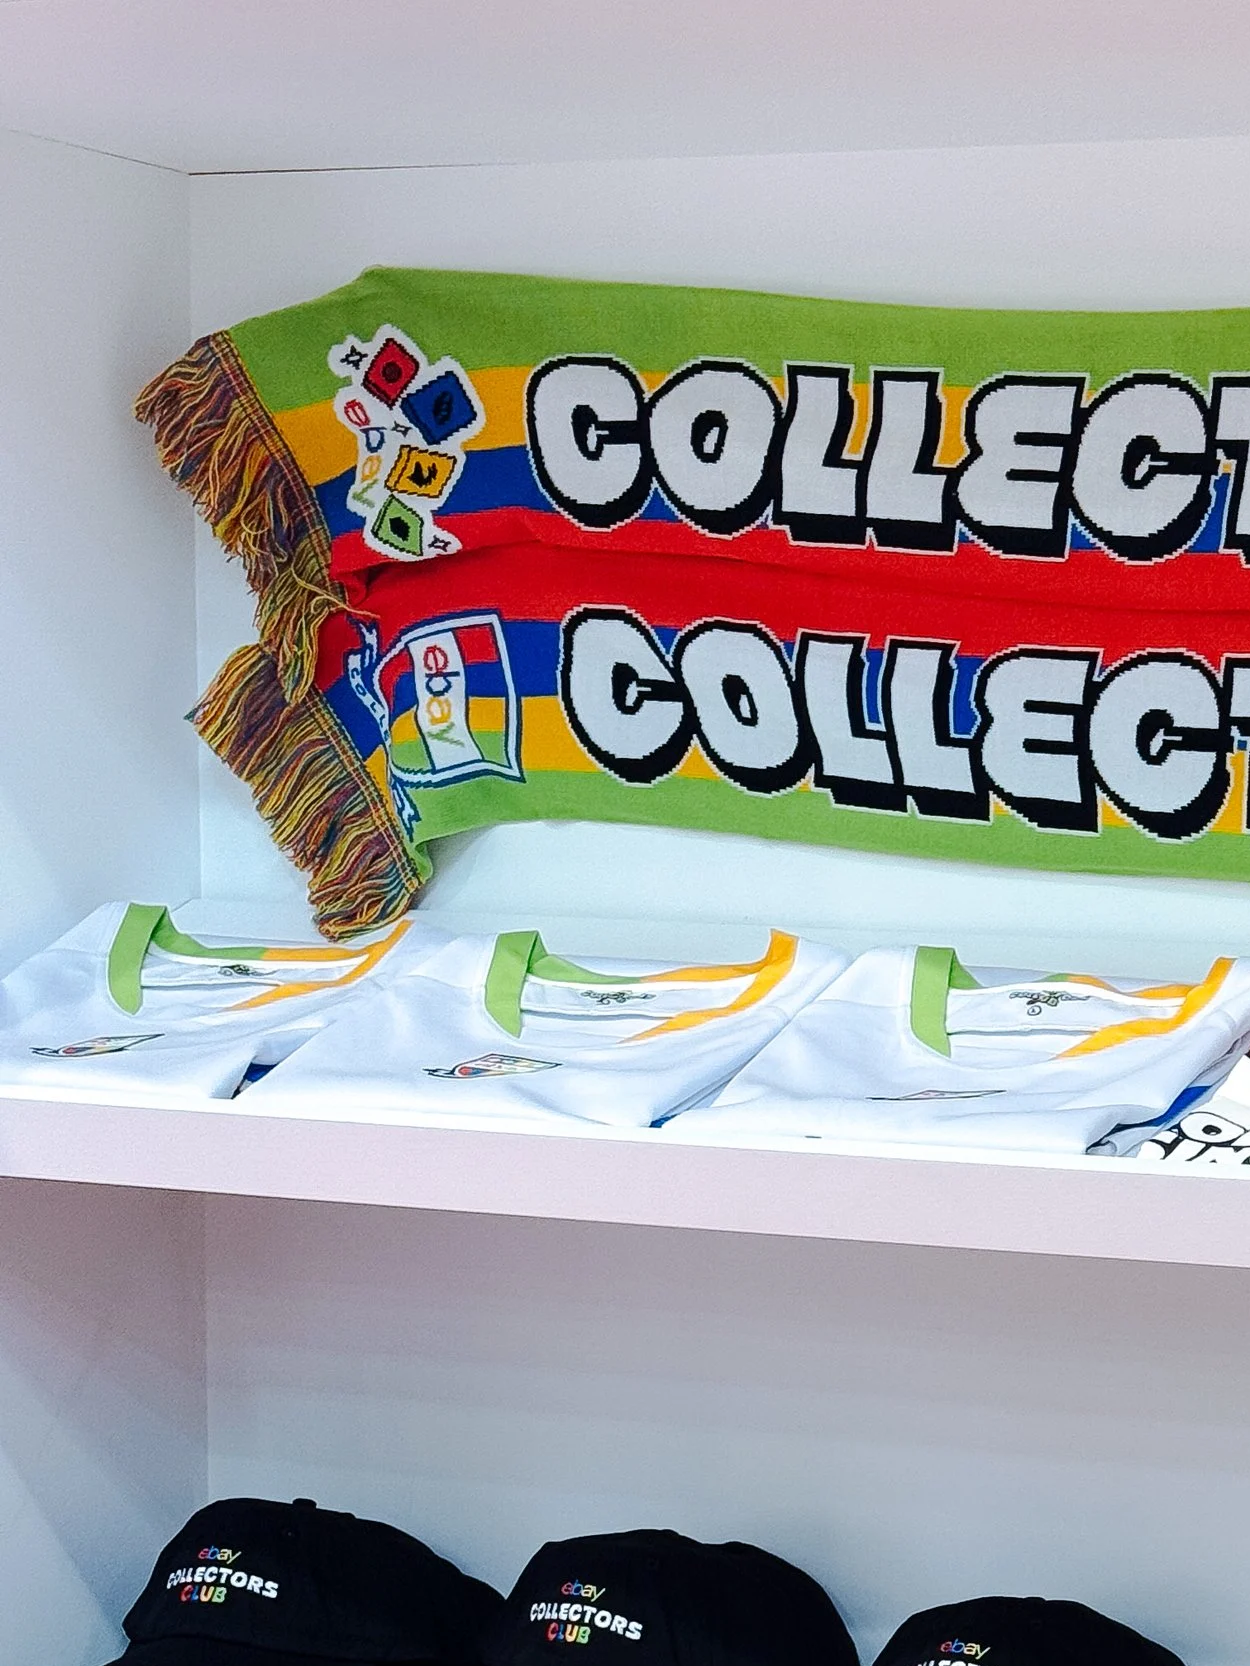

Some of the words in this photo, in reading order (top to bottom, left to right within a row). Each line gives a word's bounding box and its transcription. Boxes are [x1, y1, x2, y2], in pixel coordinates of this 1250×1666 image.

[423, 645, 465, 747] ebay
[198, 1545, 242, 1564] ebay
[166, 1566, 279, 1599] COLLECTORS
[180, 1585, 227, 1603] CLUB
[561, 1579, 606, 1602] ebay
[530, 1602, 643, 1640] COLLECTORS
[546, 1621, 591, 1644] CLUB
[940, 1638, 991, 1660] ebay
